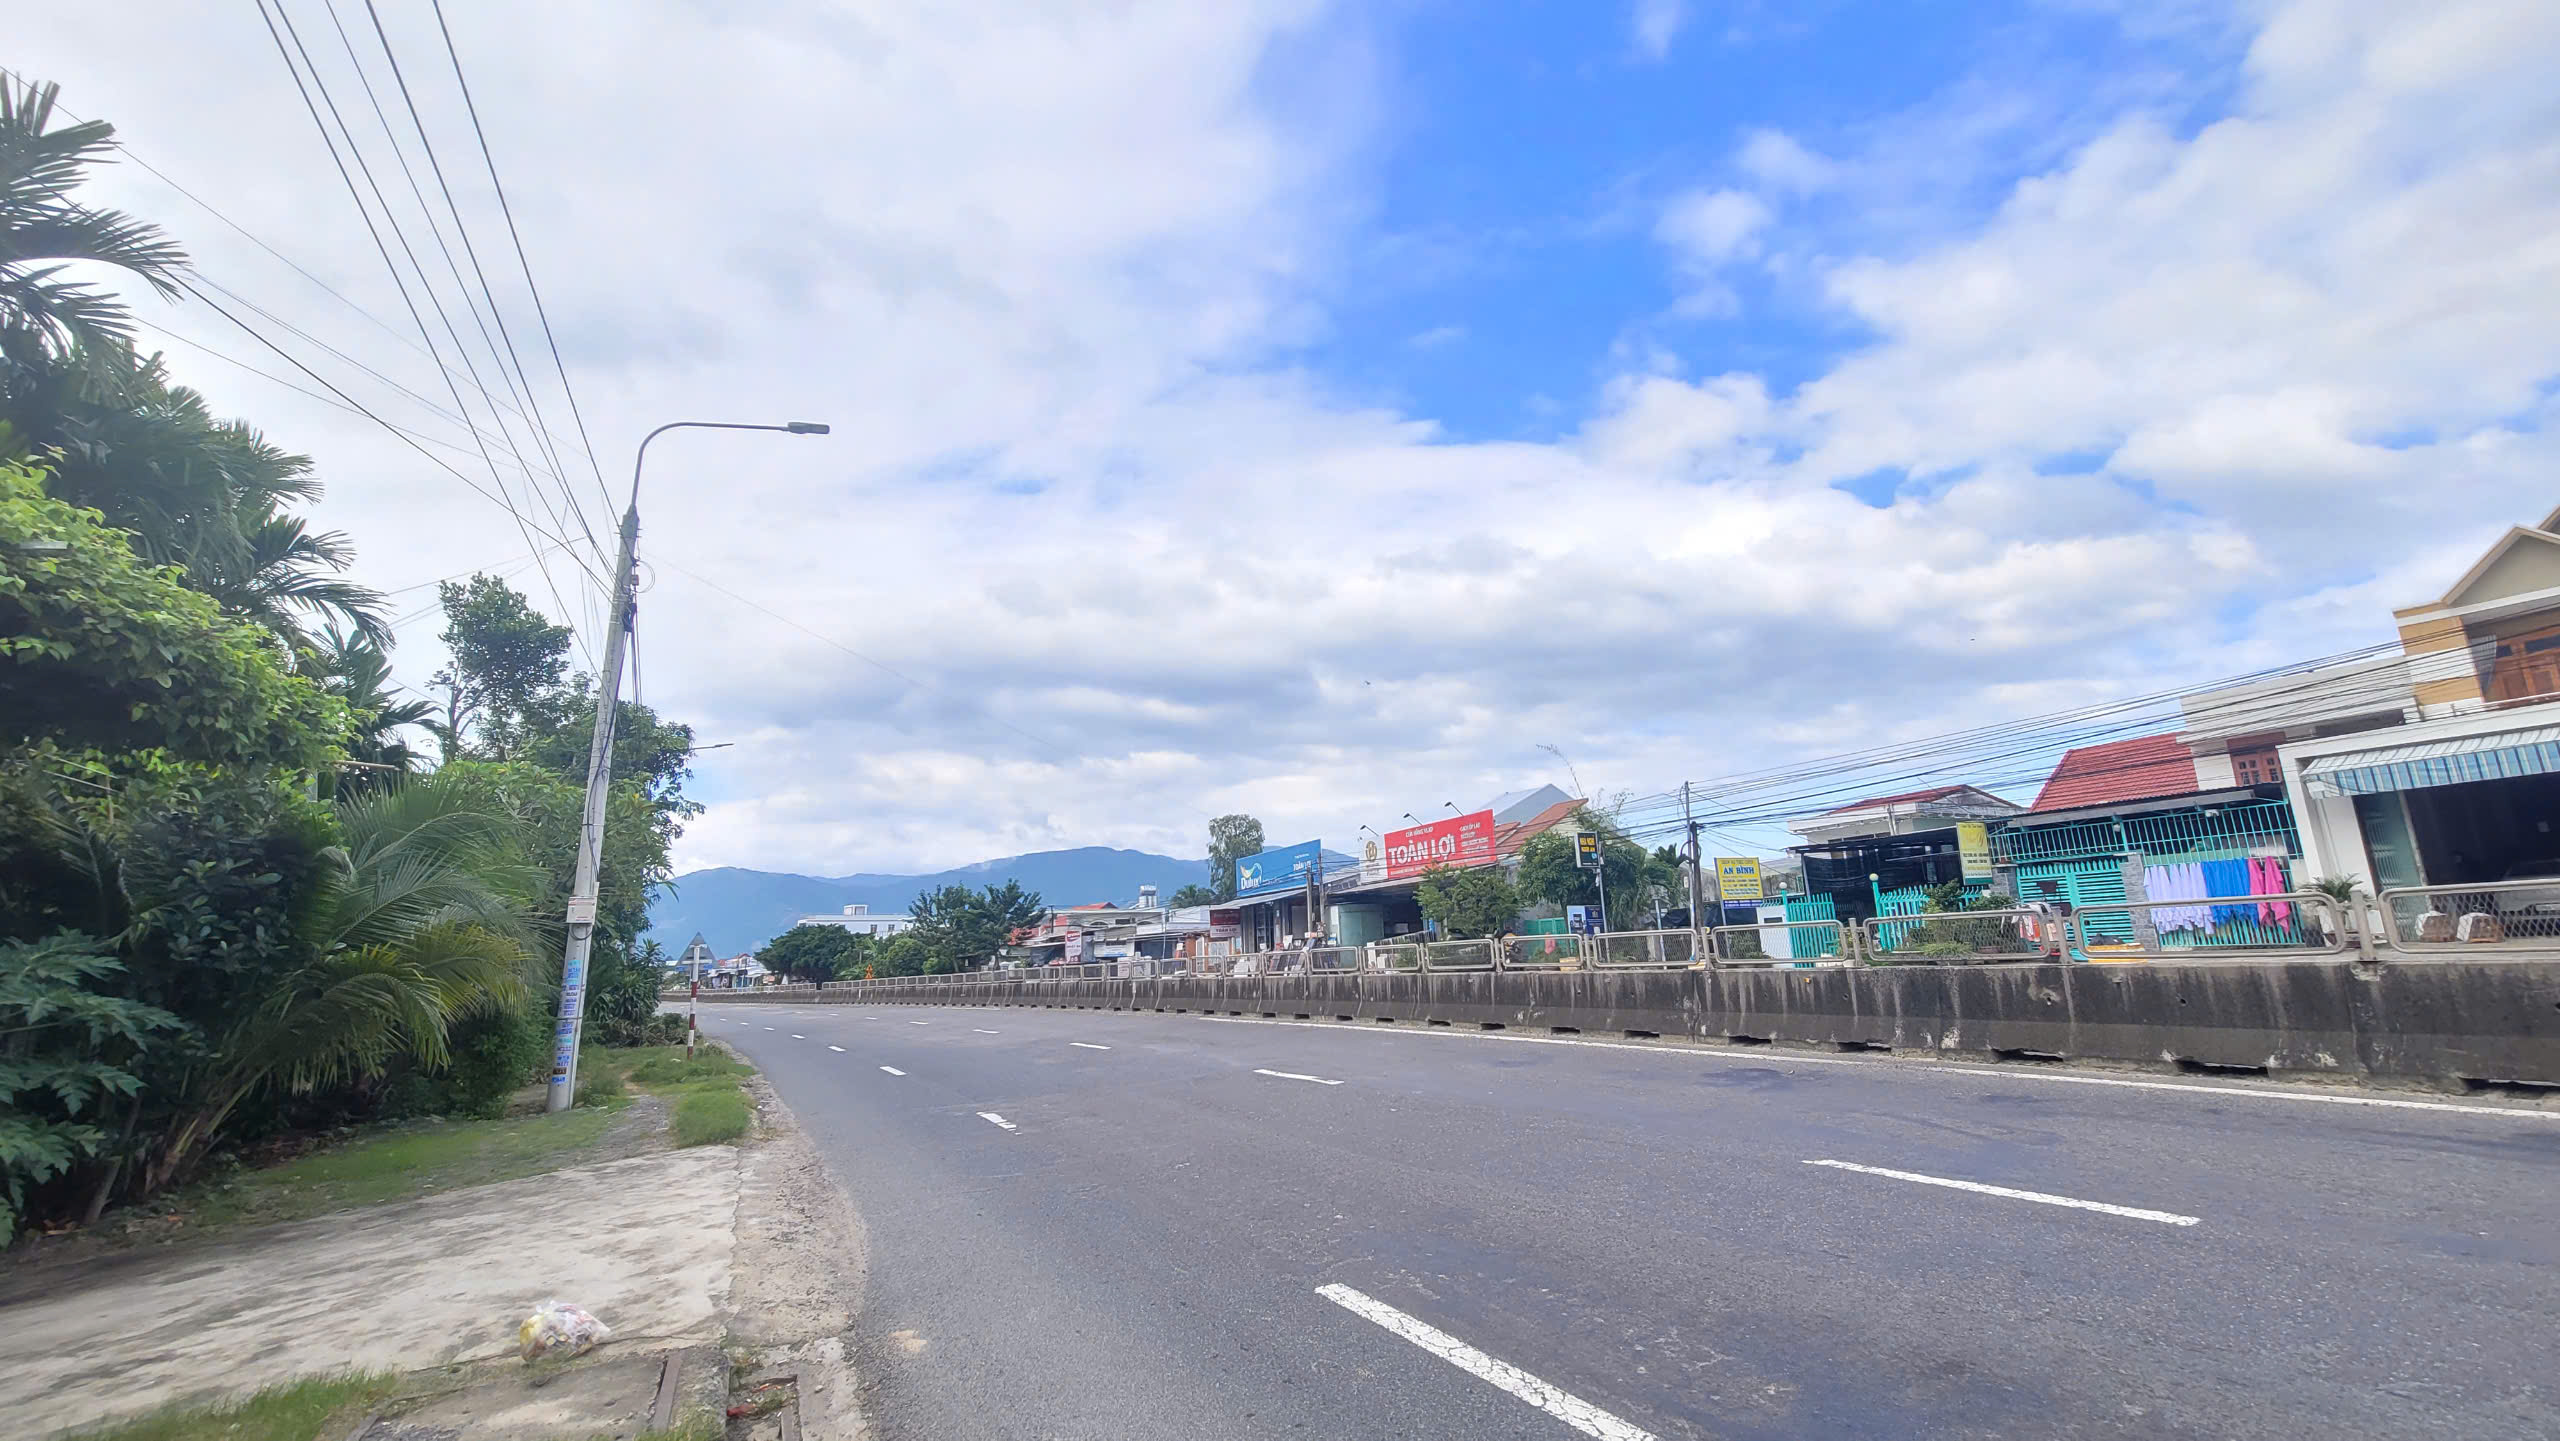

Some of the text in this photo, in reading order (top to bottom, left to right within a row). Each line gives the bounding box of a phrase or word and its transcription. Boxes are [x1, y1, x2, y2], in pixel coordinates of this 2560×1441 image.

[1388, 833, 1456, 865] TOÀN LỢI
[1723, 865, 1754, 875] AN BÌNH
